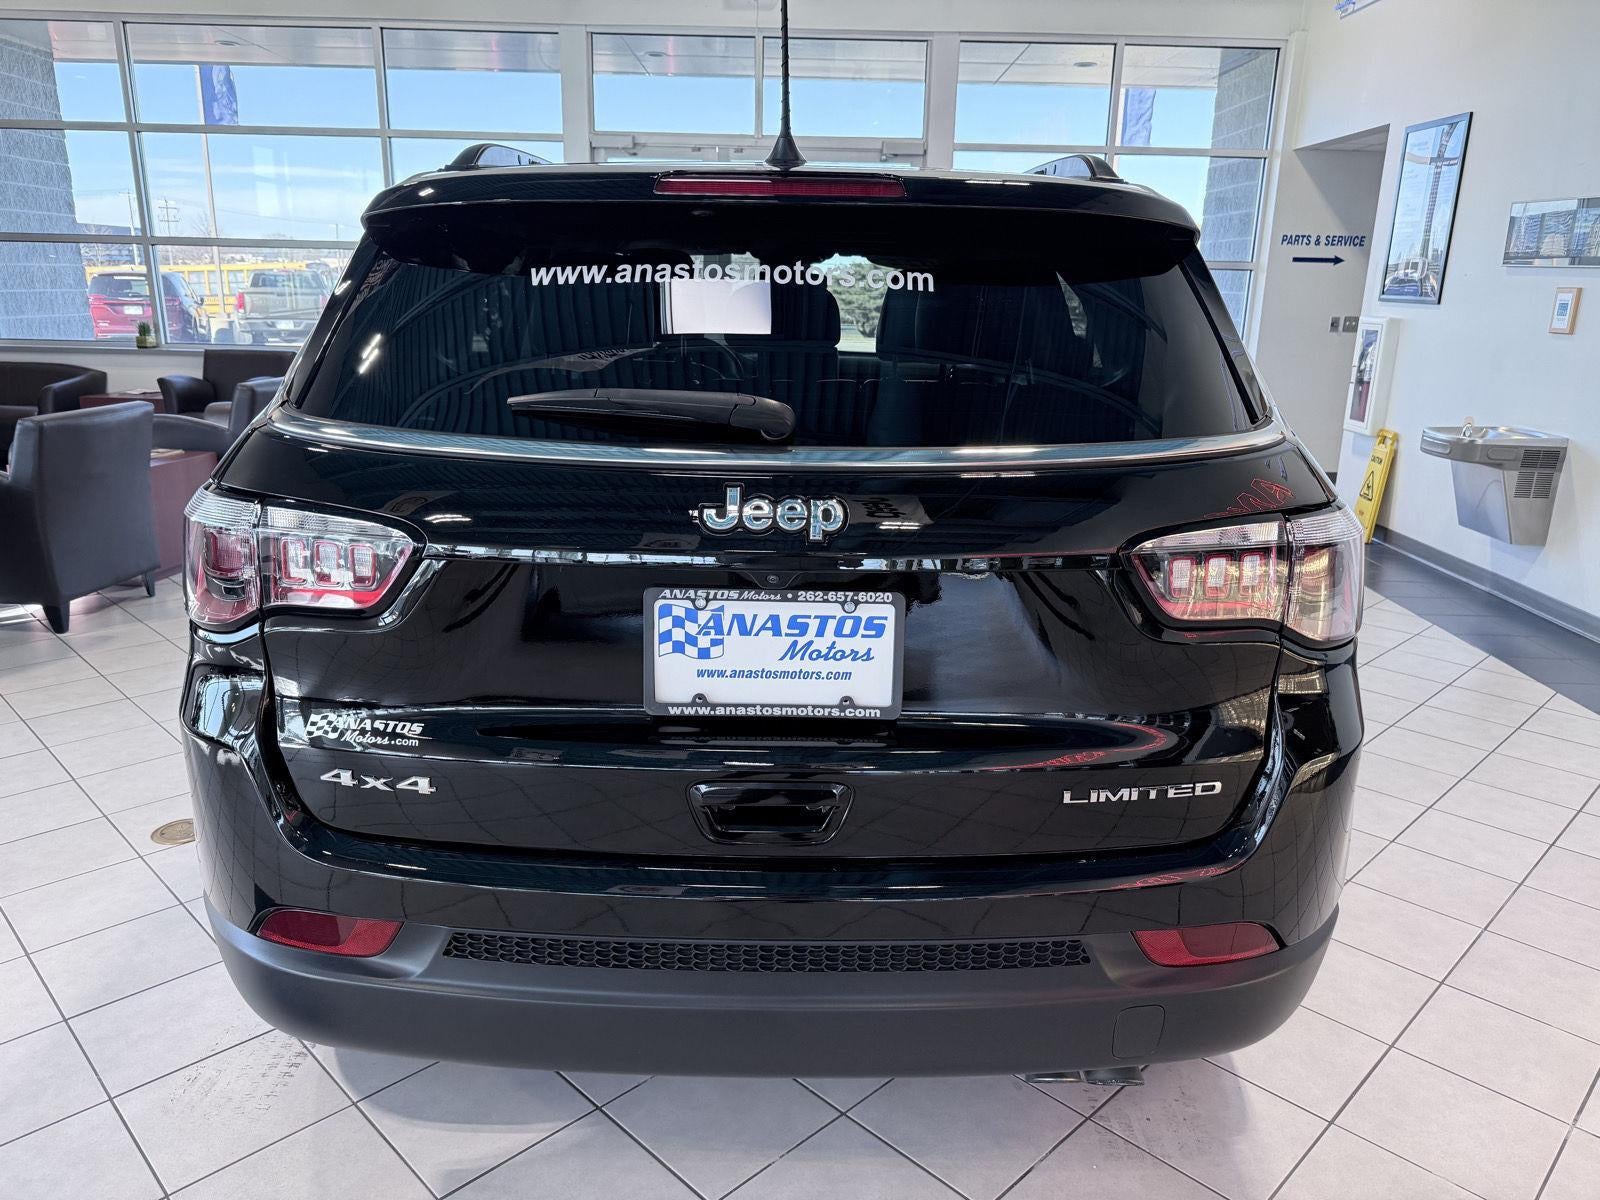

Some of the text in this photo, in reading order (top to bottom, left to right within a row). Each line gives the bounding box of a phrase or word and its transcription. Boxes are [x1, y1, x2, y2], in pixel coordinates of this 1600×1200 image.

[1281, 234, 1366, 247] PARTS & SERVICE
[530, 260, 935, 292] www.anastosmotors.com
[702, 486, 845, 541] Jeep
[658, 589, 893, 603] ANASTOS Motors 262-657-6020
[696, 610, 888, 639] ANASTOS
[778, 639, 875, 662] Motors
[696, 668, 852, 681] www.anastosmotors.com
[668, 704, 881, 718] www.anastosmotors.com
[330, 718, 424, 734] ANASTOS
[319, 768, 437, 795] 4x4
[1063, 781, 1223, 804] LIMITED
